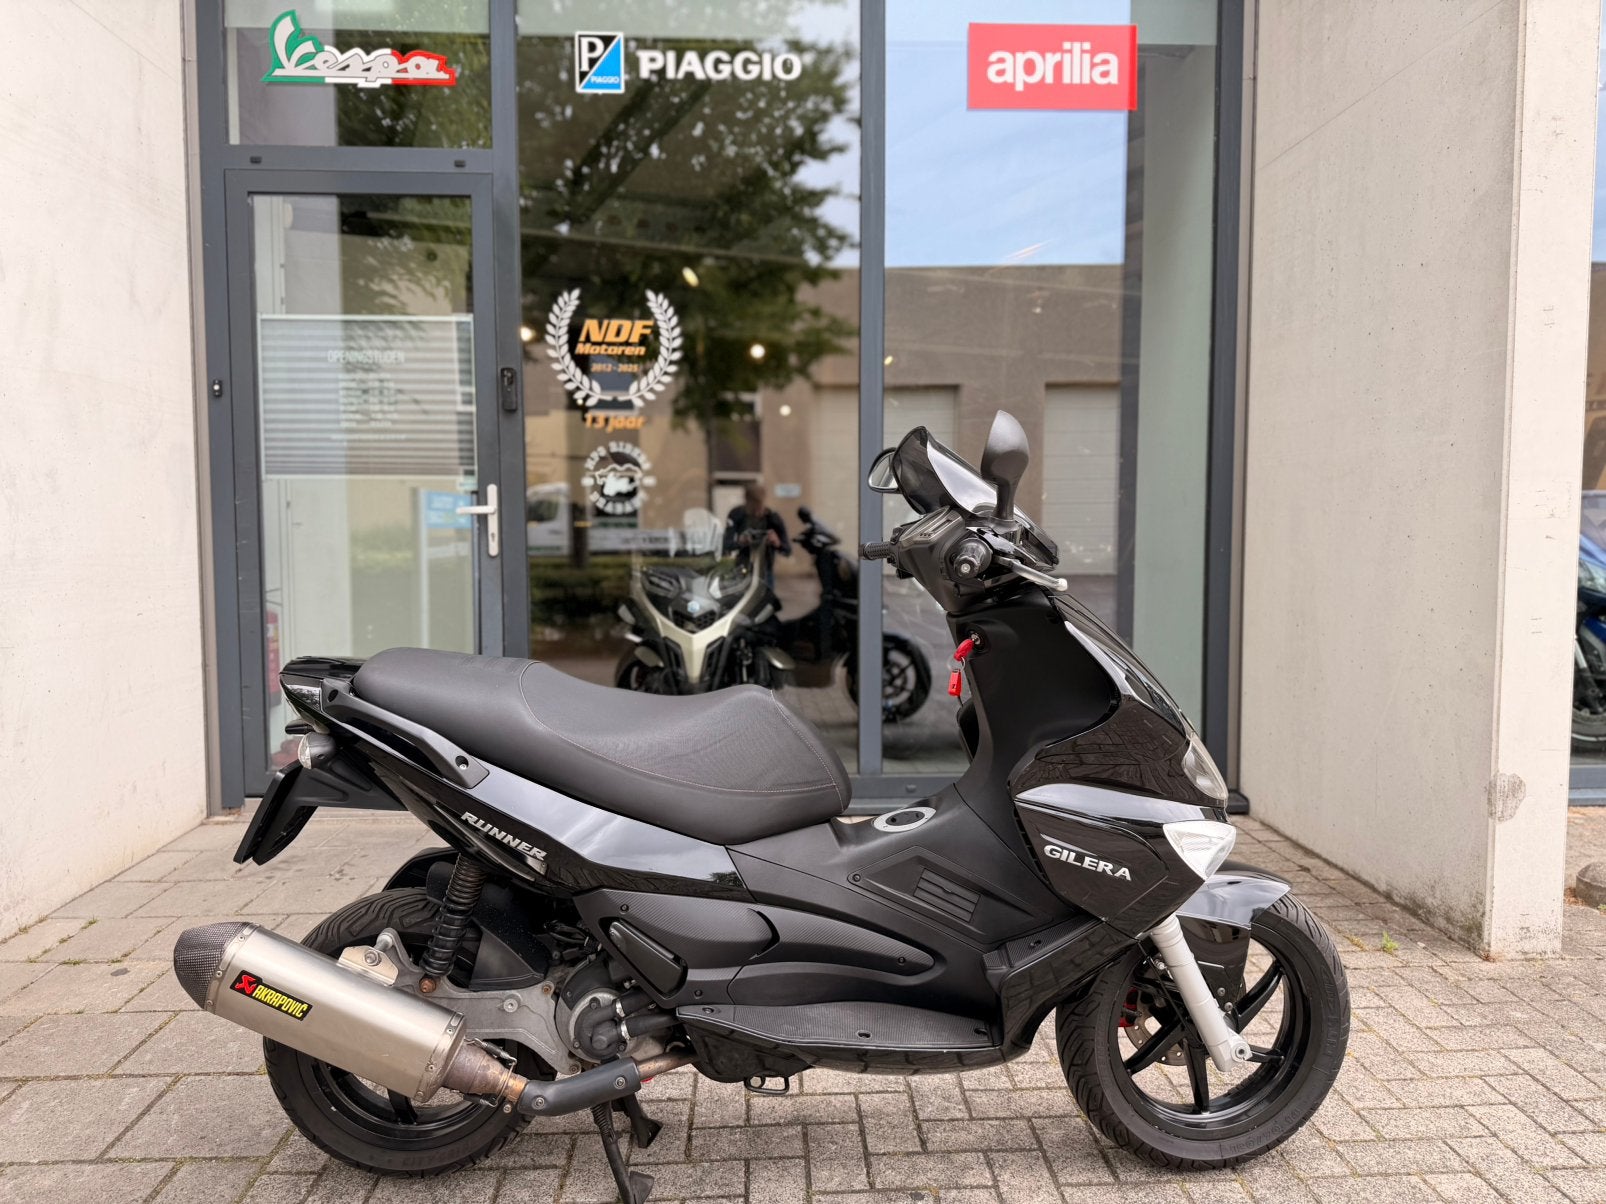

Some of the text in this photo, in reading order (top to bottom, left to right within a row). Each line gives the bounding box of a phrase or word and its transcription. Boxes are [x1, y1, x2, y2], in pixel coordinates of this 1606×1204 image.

[271, 14, 451, 83] Vespa
[635, 49, 802, 81] PIAGGIO
[986, 41, 1119, 92] aprilia
[578, 319, 654, 343] NDF
[575, 342, 647, 356] Motoren
[584, 412, 647, 433] 13 jaar
[461, 811, 547, 861] RUNNER
[1043, 844, 1132, 881] GILERA
